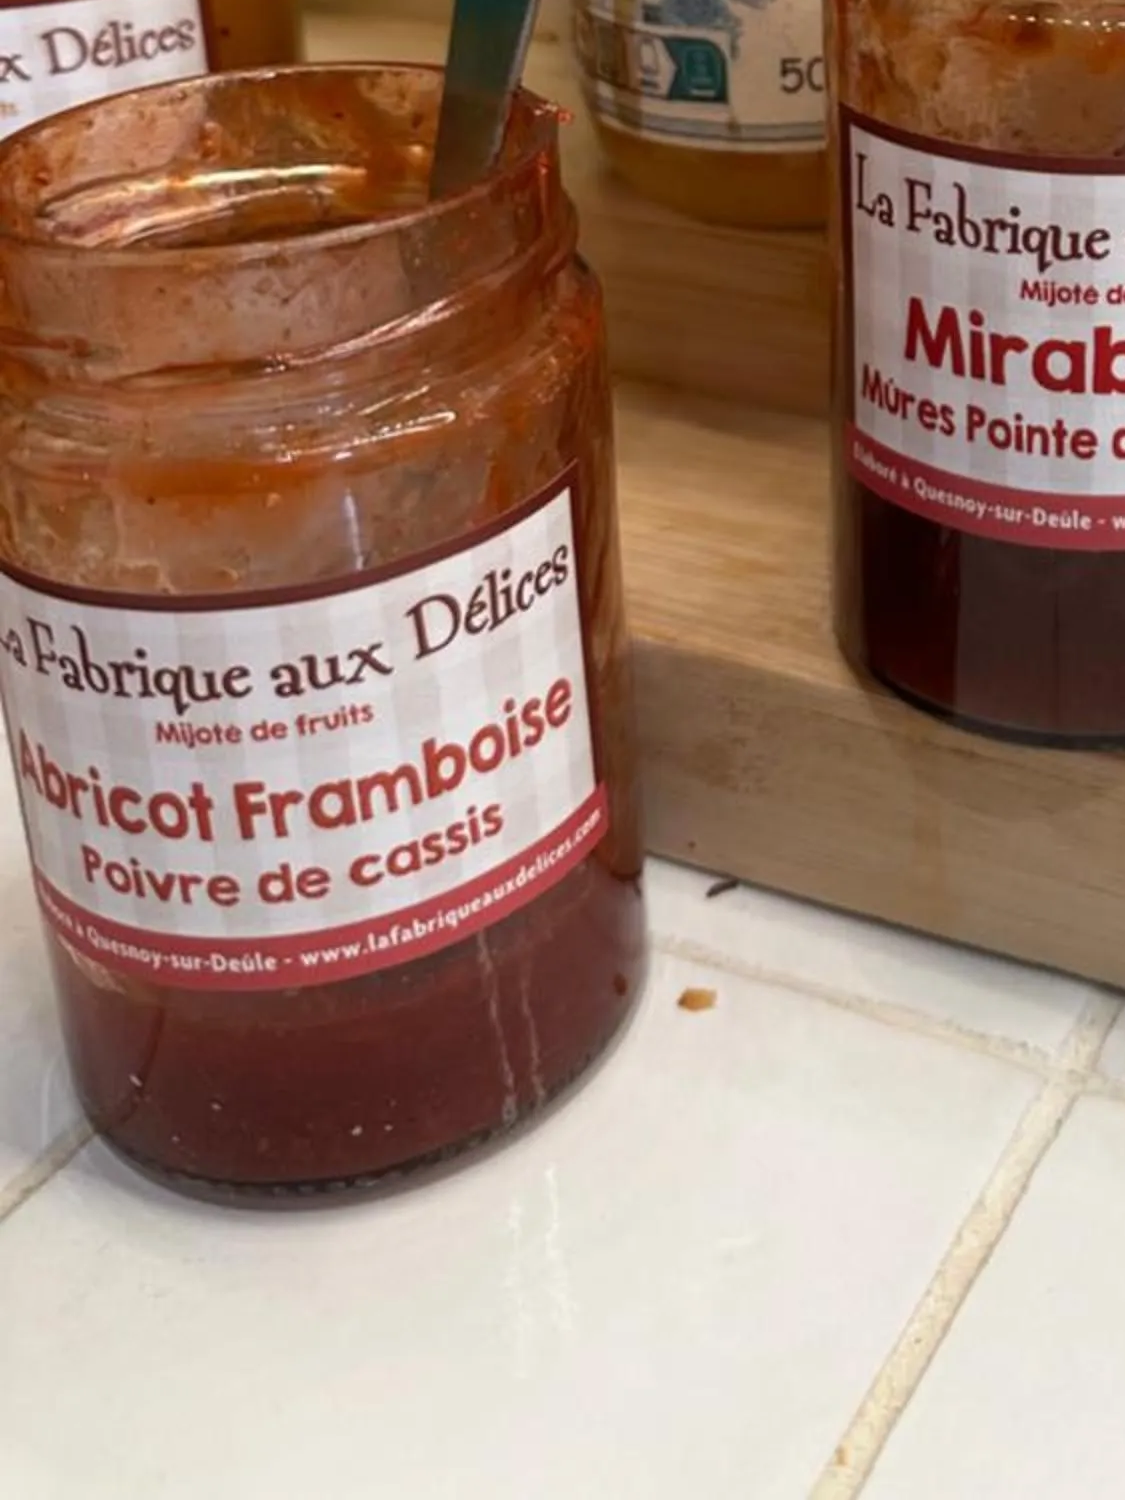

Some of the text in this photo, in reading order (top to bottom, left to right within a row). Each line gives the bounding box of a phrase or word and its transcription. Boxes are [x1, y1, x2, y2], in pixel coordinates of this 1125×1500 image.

[41, 18, 197, 76] Délices
[855, 152, 895, 227] La
[905, 177, 1111, 273] Fabrique
[1020, 278, 1098, 307] Mijoté
[966, 403, 1098, 460] Pointe
[26, 616, 252, 716] Fabrique
[271, 641, 395, 698] aux
[404, 544, 569, 660] Délices
[18, 677, 573, 842] Abricot Framboise
[155, 702, 374, 749] Mijoté de fruits
[81, 844, 242, 907] Poivre
[257, 861, 331, 904] de
[349, 802, 505, 887] cassis
